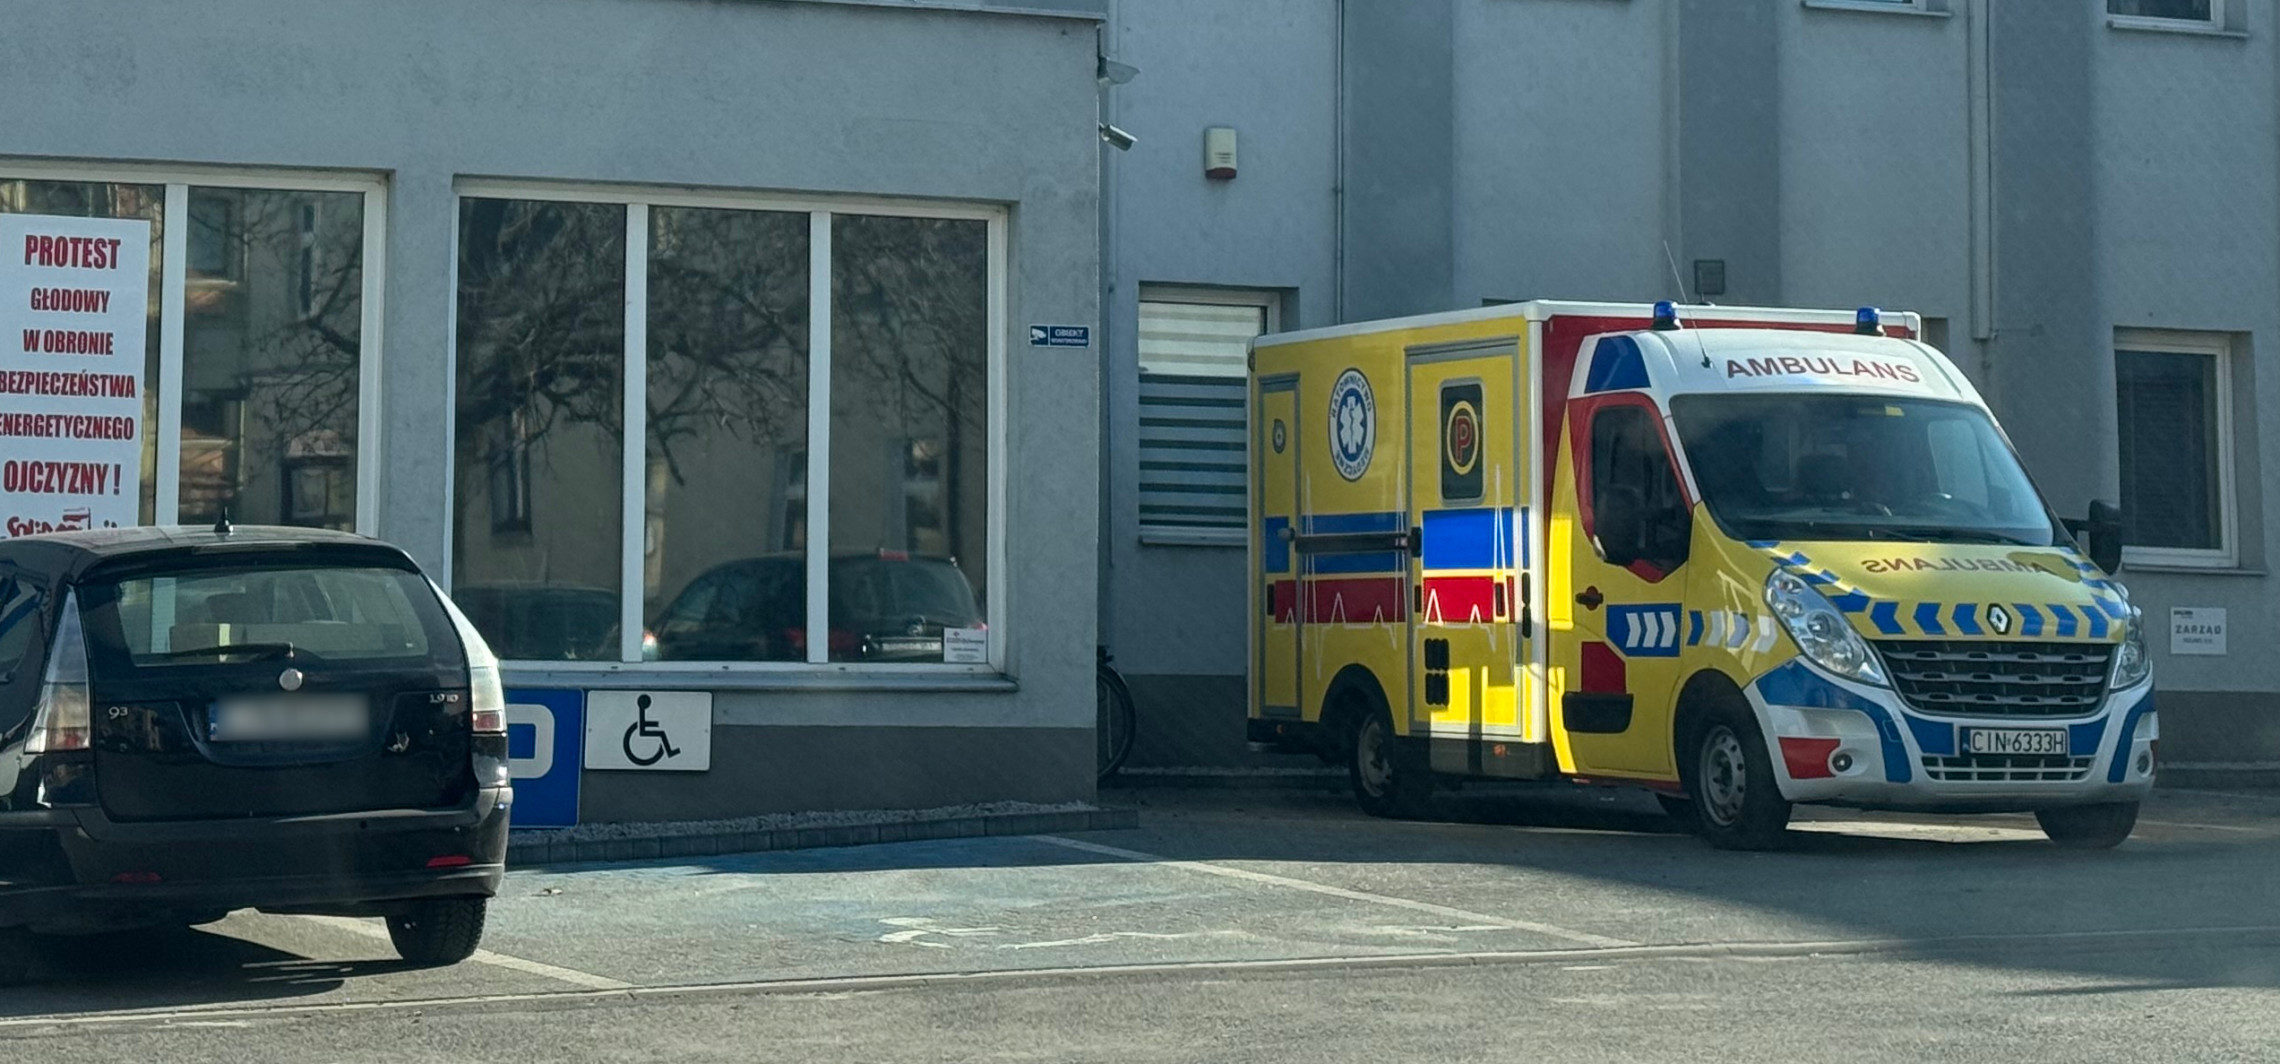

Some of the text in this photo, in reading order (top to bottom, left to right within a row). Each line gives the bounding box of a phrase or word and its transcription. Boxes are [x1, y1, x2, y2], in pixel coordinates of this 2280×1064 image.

[24, 234, 121, 269] PROTEST
[30, 287, 110, 313] GŁODOWY
[23, 329, 114, 355] W OBRONIE
[1726, 356, 1921, 383] AMBULANS
[1455, 415, 1473, 463] P
[3, 460, 122, 496] OJCZYZNY !
[1972, 731, 2064, 753] CIN 6333H
